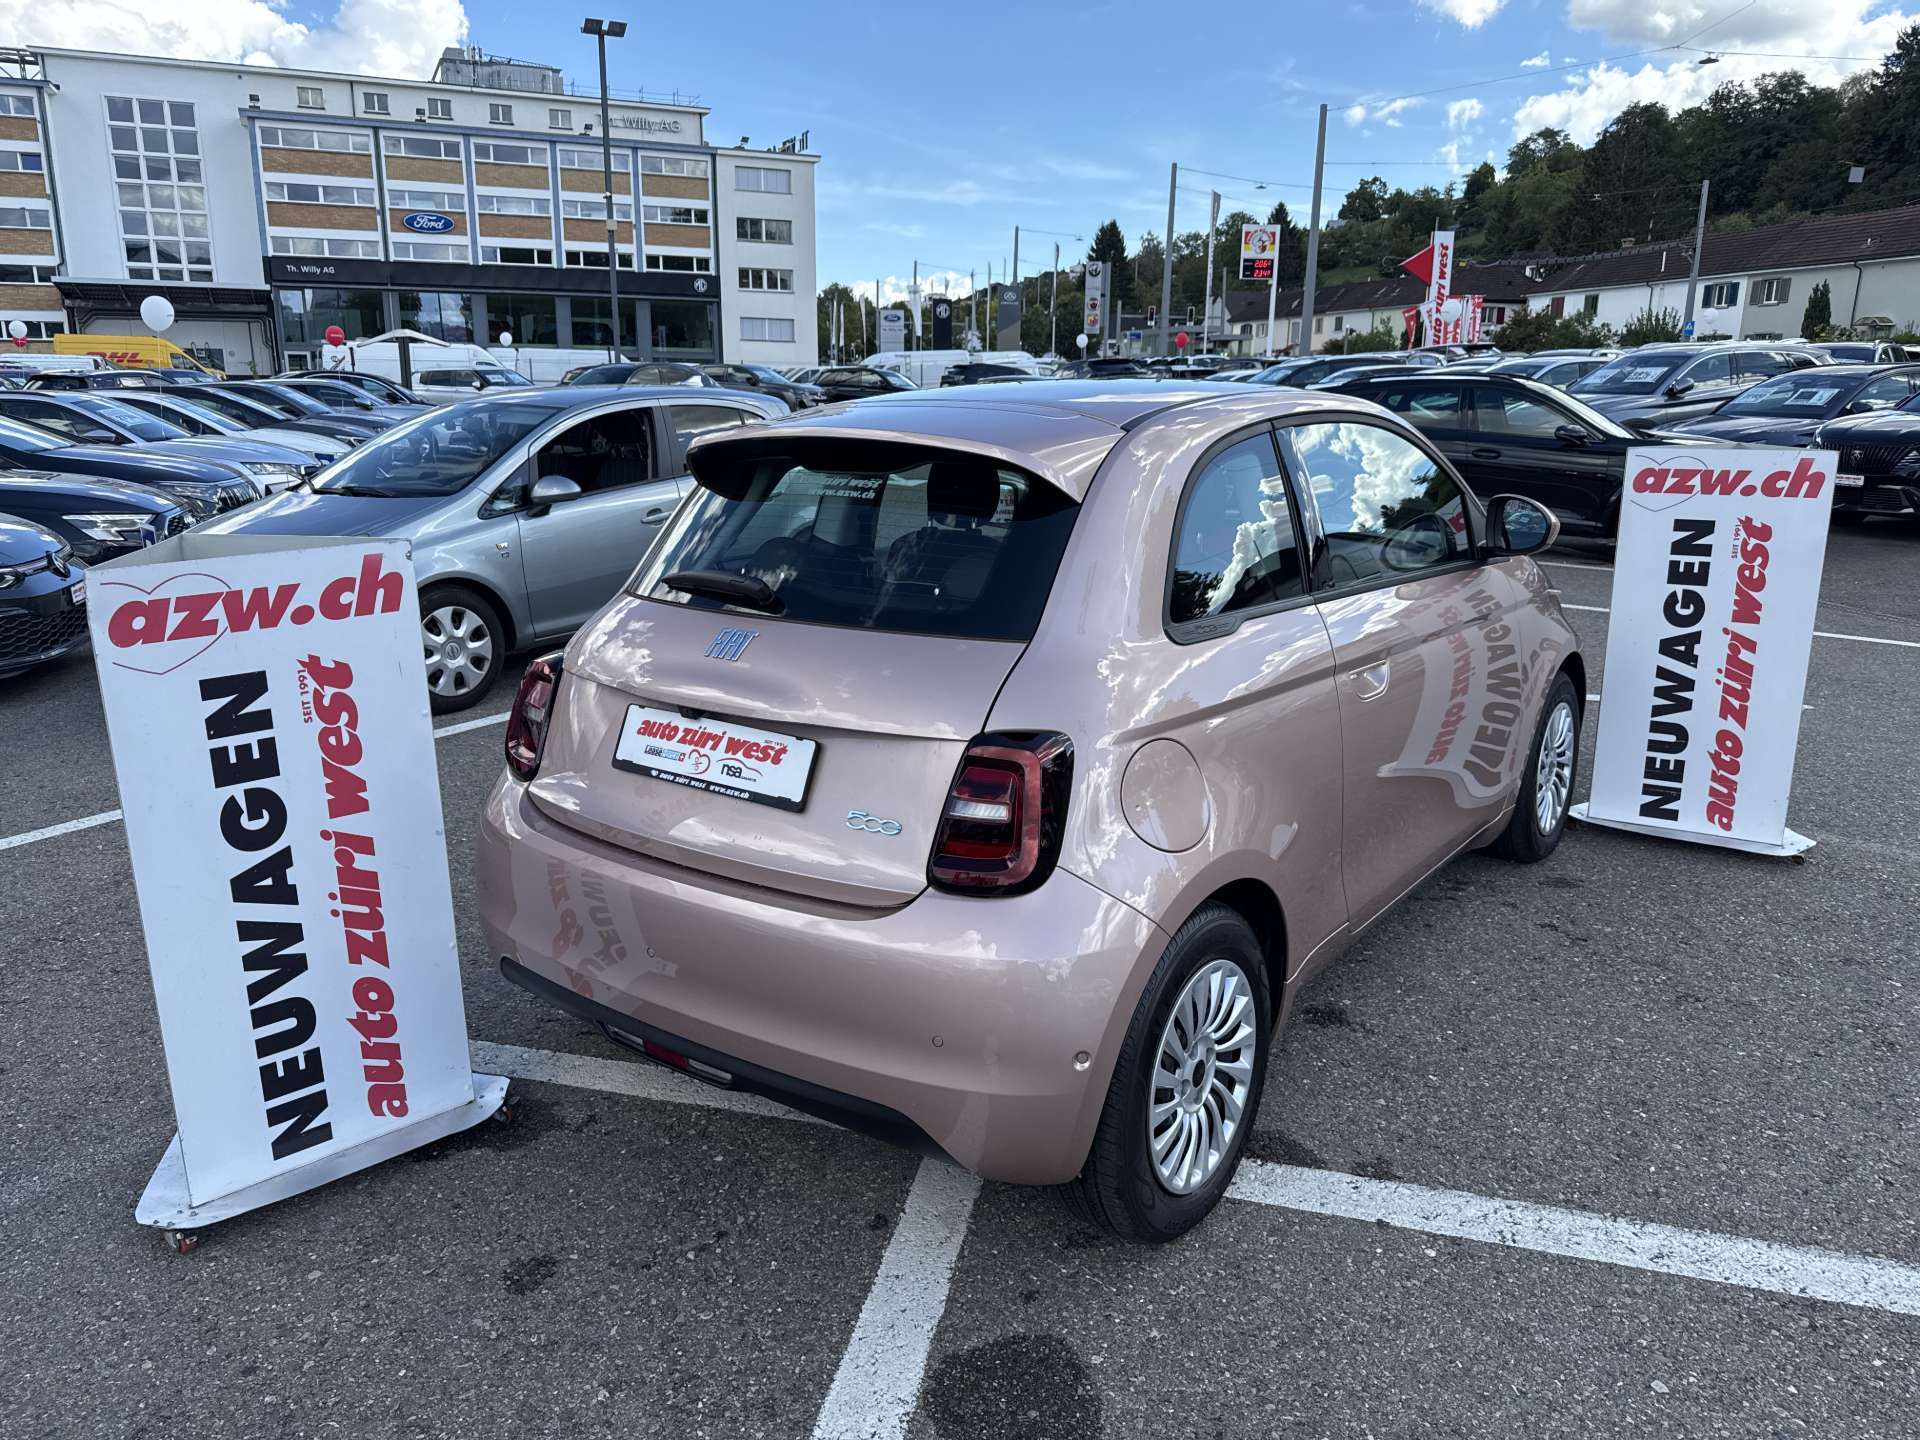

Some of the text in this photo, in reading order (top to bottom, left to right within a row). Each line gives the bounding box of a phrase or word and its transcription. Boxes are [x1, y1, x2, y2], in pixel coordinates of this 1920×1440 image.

[622, 113, 656, 131] Willy
[660, 118, 681, 131] AG
[413, 214, 446, 230] Ford
[286, 264, 335, 275] Th. Willy AG
[1438, 242, 1449, 280] west
[1632, 457, 1828, 499] azw.ch
[1731, 524, 1741, 559] SEIT 1991
[107, 552, 404, 649] azw.ch
[704, 627, 759, 661] FIAT
[1638, 519, 1716, 822] NEUWAGEN
[1706, 515, 1774, 832] auto züri west
[297, 669, 313, 724] SEIT 1991
[636, 719, 790, 765] auto züri west
[720, 763, 743, 778] nsa
[846, 810, 902, 836] 500
[296, 653, 409, 1118] auto züri west
[198, 670, 334, 1161] NEUWAGEN
